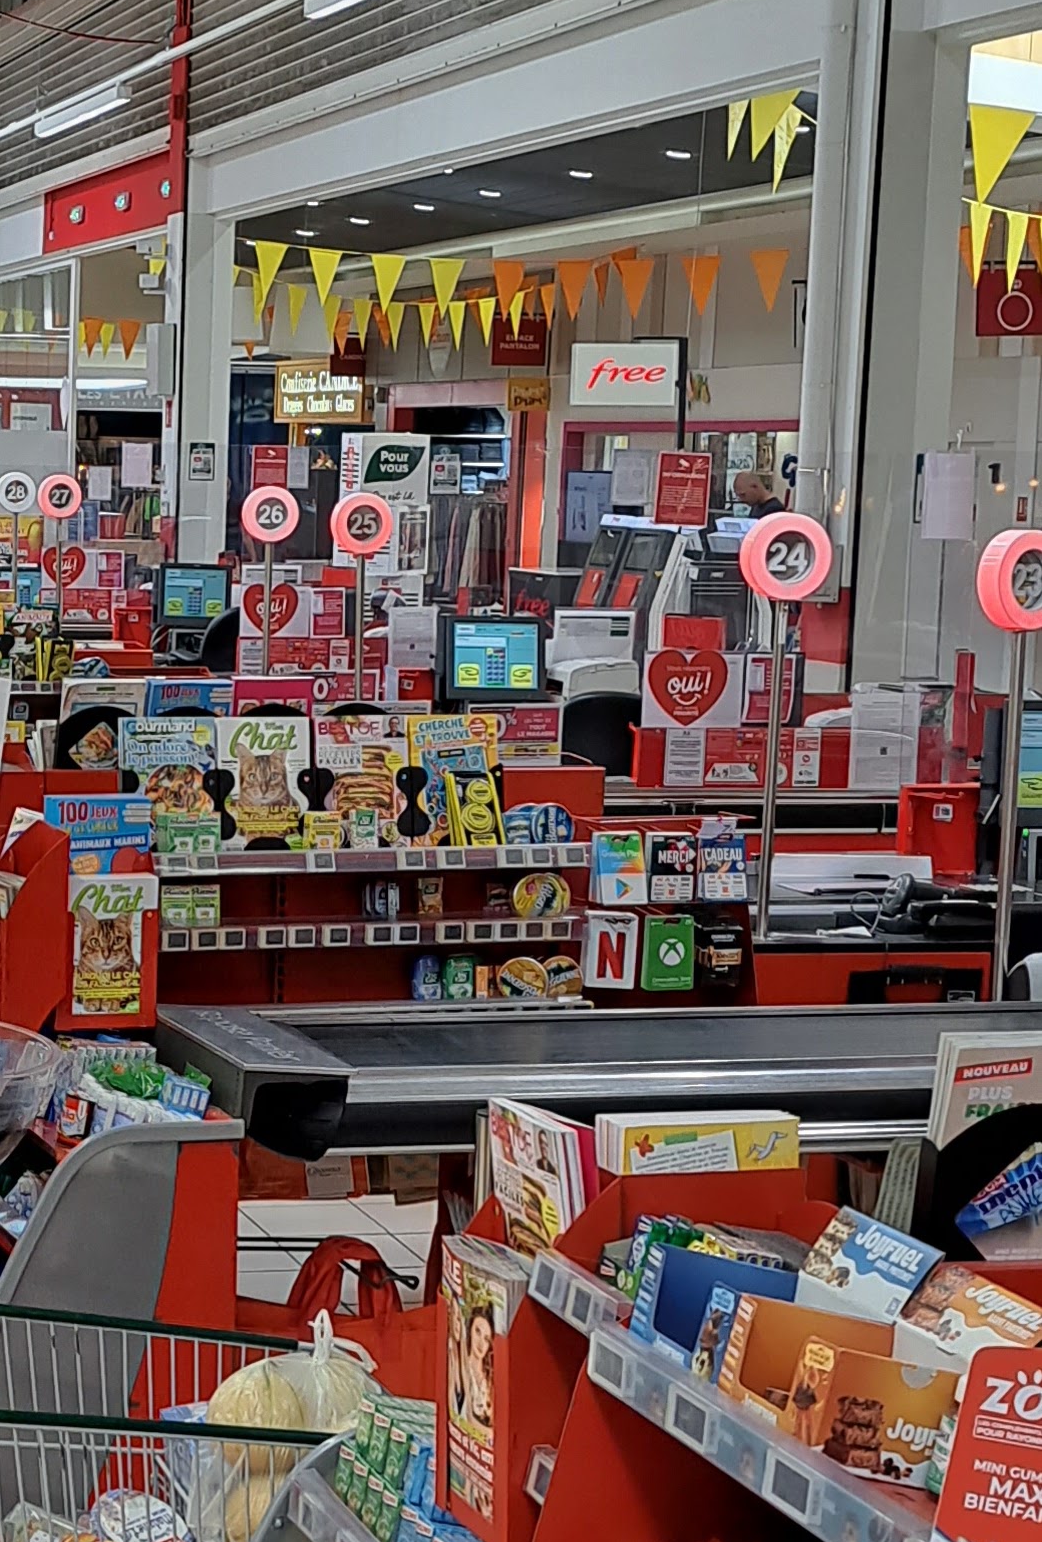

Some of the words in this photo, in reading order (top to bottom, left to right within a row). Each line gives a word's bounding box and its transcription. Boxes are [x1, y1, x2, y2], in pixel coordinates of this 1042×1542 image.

[586, 358, 667, 390] free
[380, 450, 410, 462] Pour
[379, 463, 409, 473] vous
[6, 484, 26, 500] 28
[51, 489, 71, 506] 27
[258, 505, 284, 525] 26
[349, 513, 378, 535] 25
[768, 541, 807, 571] 24
[666, 670, 711, 695] oui!
[418, 717, 464, 733] CHERCHE
[229, 721, 298, 758] Chat
[58, 800, 89, 825] 100
[90, 802, 119, 819] JEUX
[657, 849, 690, 864] MERCI
[704, 847, 743, 861] CADEAU
[72, 883, 145, 912] Chat
[596, 930, 627, 980] N
[961, 1060, 1029, 1080] NOUVEAU
[967, 1085, 1014, 1101] PLUS
[973, 1459, 1007, 1476] MINI
